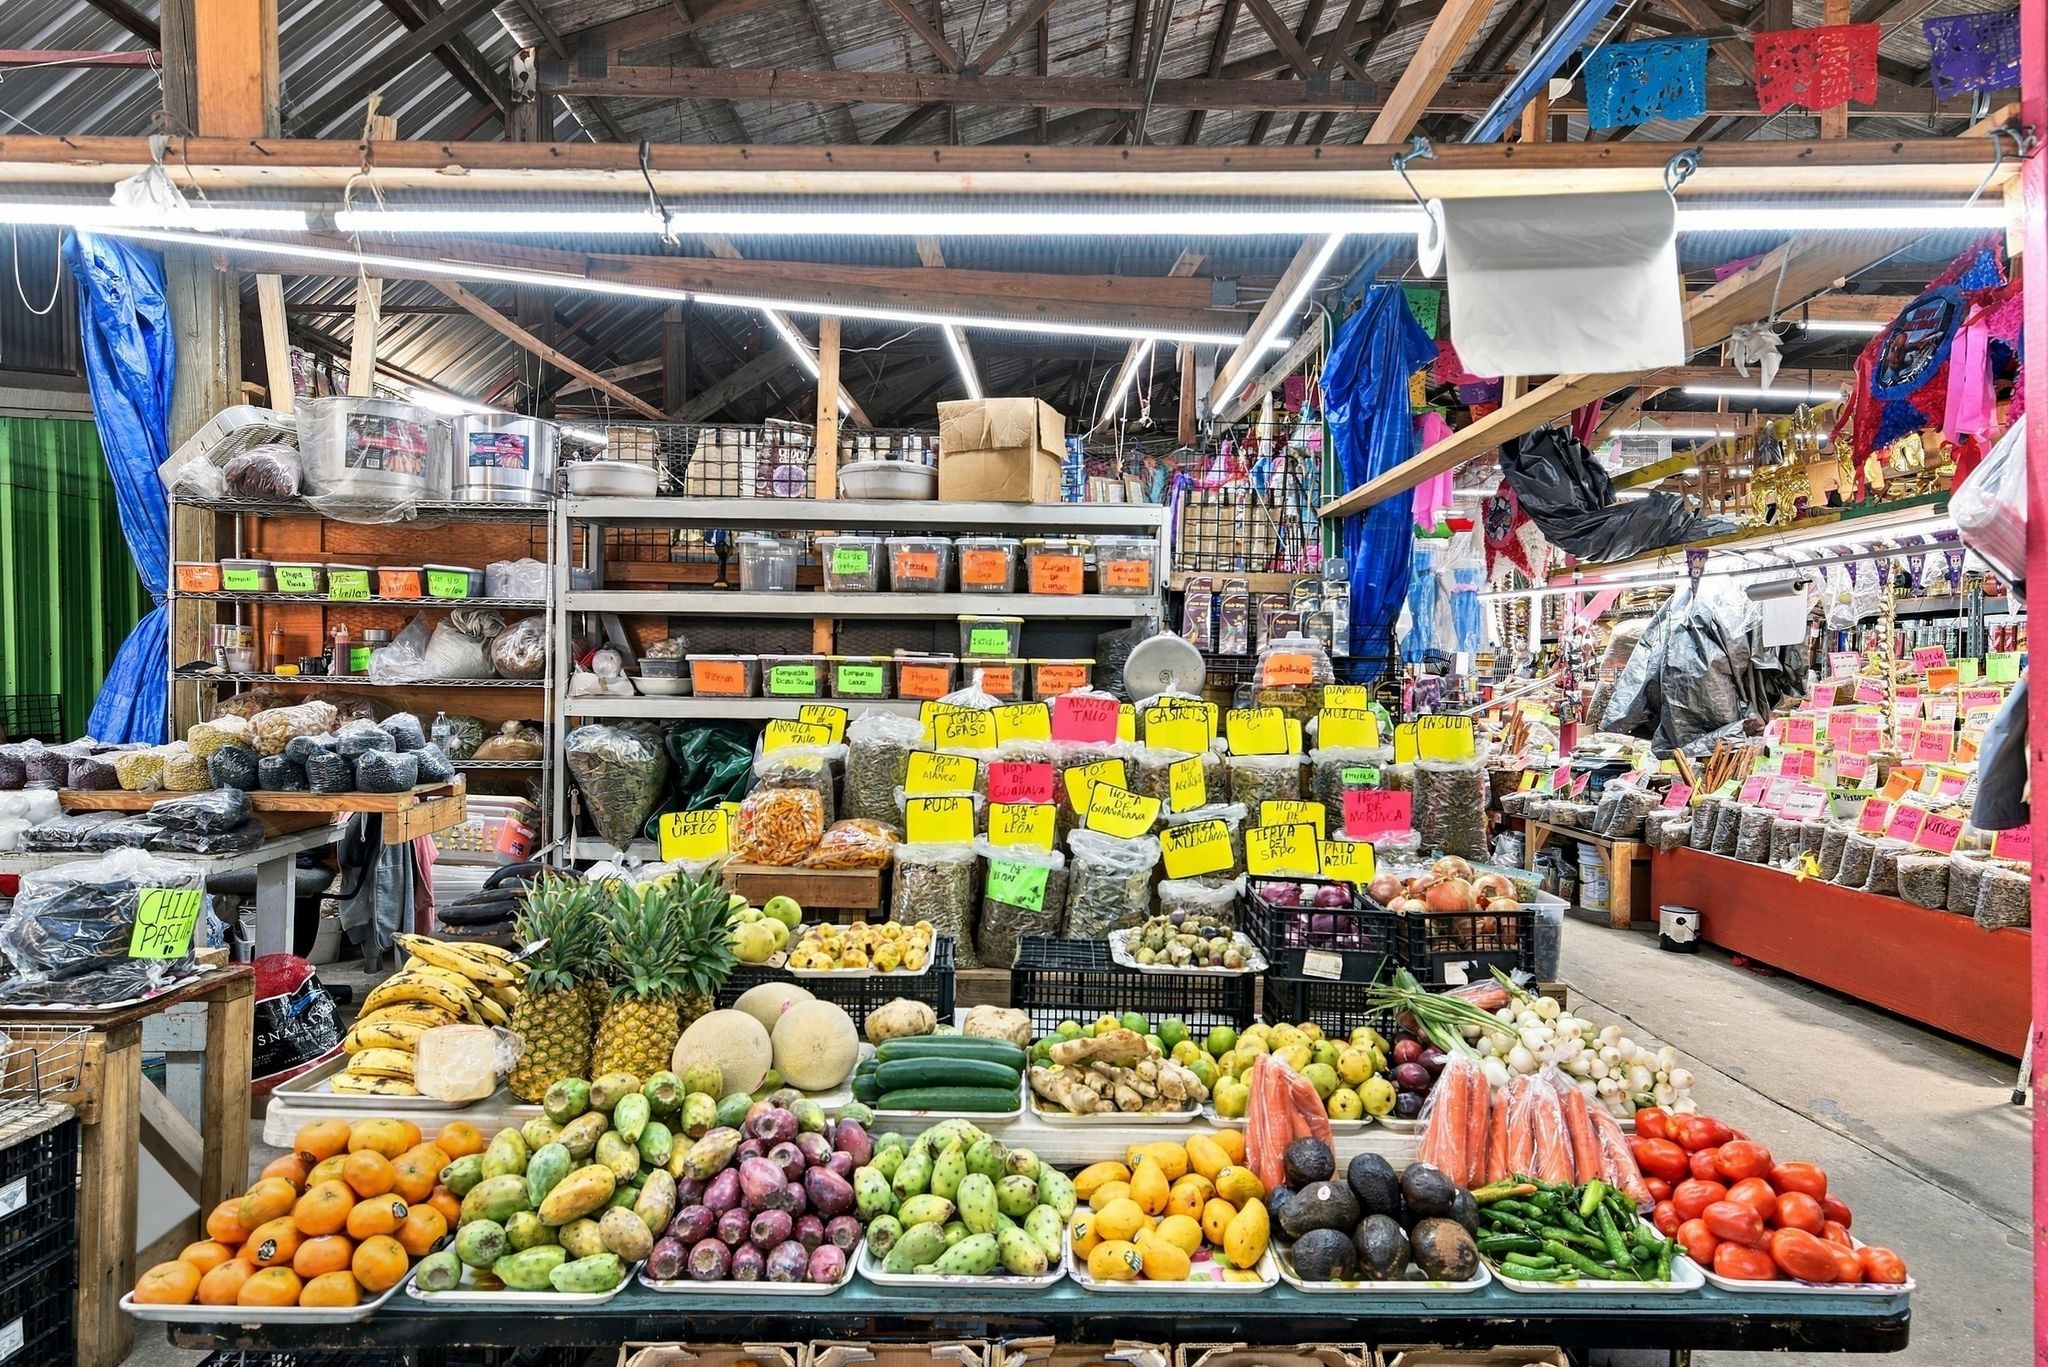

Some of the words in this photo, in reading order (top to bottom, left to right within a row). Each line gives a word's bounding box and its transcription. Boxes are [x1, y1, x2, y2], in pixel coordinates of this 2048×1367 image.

[1002, 706, 1042, 718] COLON
[1072, 710, 1108, 722] TALLO
[1229, 708, 1274, 721] PROSTATA
[772, 720, 811, 733] ARNICA
[946, 723, 986, 738] GRASO
[928, 754, 960, 766] HOJA
[1002, 764, 1032, 775] HOJA
[1012, 775, 1024, 784] DE
[1357, 792, 1391, 804] HOJA
[923, 797, 959, 812] RUDA
[1275, 802, 1308, 812] HOJA
[1366, 804, 1382, 813] DE
[673, 811, 720, 826] ACIDO
[1012, 813, 1025, 825] DE
[671, 822, 717, 839] URICO
[1260, 847, 1297, 861] SAPO
[1323, 843, 1355, 854] PALO
[1324, 855, 1358, 867] AZUL
[138, 889, 198, 927] CHILE
